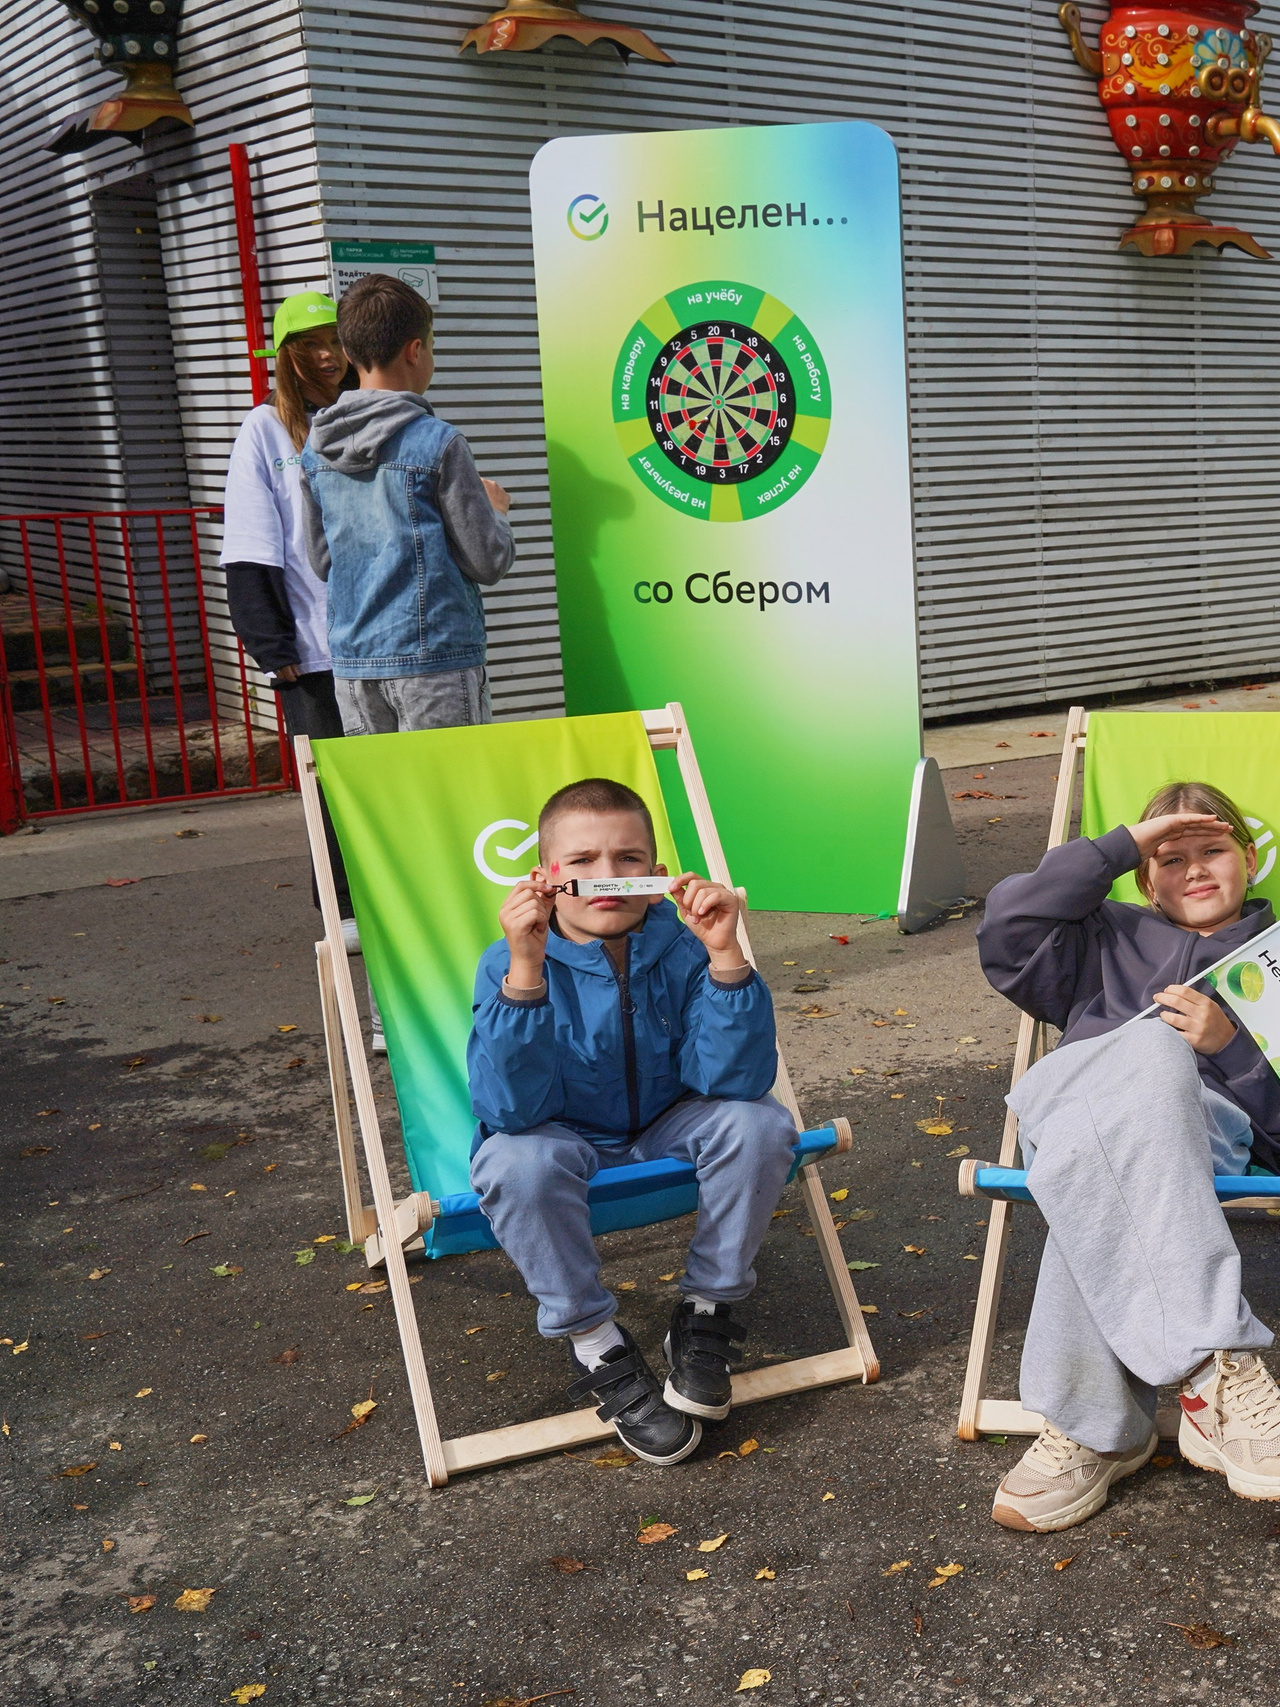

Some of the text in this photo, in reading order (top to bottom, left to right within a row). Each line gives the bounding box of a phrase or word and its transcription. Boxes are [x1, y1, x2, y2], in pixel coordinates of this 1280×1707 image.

[637, 199, 848, 236] Нацелен...
[687, 289, 743, 305] на учёбу
[691, 330, 698, 339] 5
[707, 326, 720, 335] 20
[730, 328, 735, 337] 1
[670, 341, 681, 351] 12
[747, 337, 758, 347] 18
[660, 357, 667, 366] 9
[764, 354, 771, 363] 4
[792, 334, 822, 402] на работу
[621, 336, 646, 410] на карьеру
[774, 372, 785, 382] 13
[651, 378, 661, 387] 14
[780, 394, 787, 403] 6
[650, 401, 659, 410] 11
[656, 423, 663, 432] 8
[777, 418, 787, 428] 10
[663, 441, 673, 450] 16
[770, 436, 780, 446] 15
[680, 456, 687, 465] 7
[757, 454, 763, 463] 2
[696, 466, 706, 475] 19
[720, 469, 726, 478] 3
[739, 465, 749, 474] 17
[638, 455, 706, 510] на результат
[756, 464, 802, 504] на успех
[633, 570, 831, 612] со Сбером
